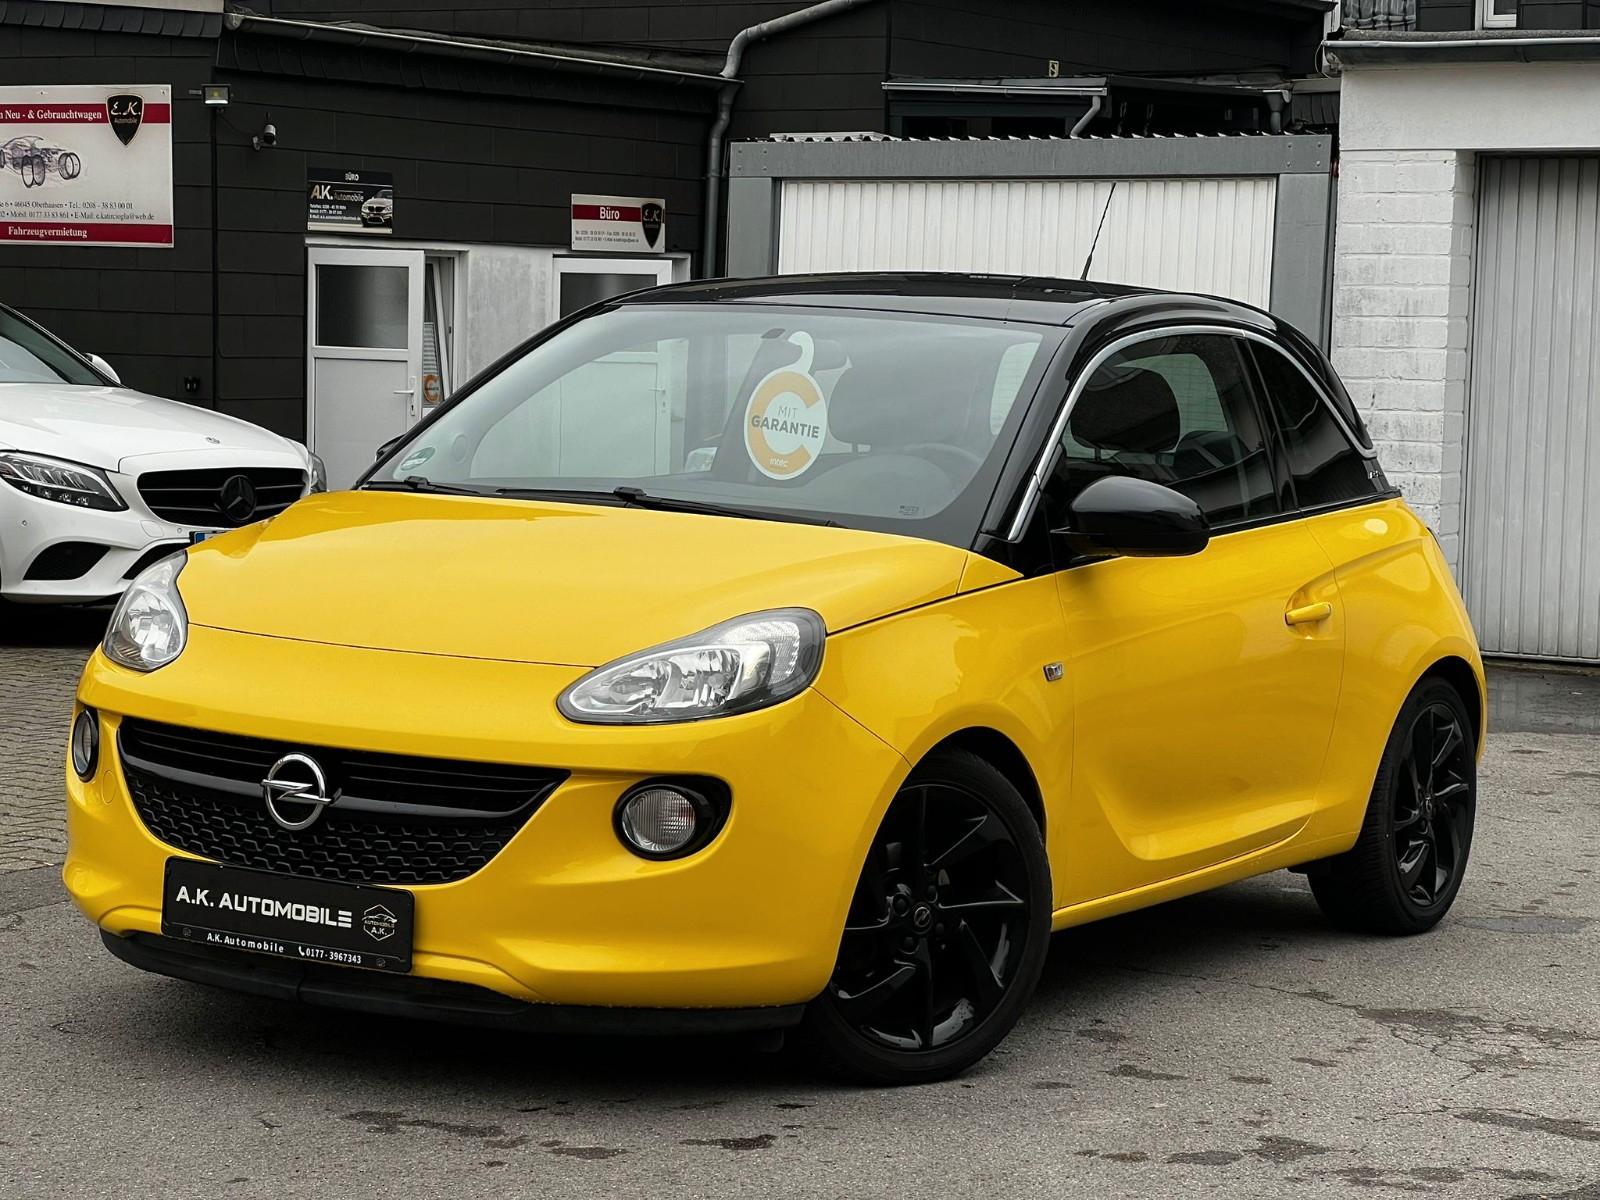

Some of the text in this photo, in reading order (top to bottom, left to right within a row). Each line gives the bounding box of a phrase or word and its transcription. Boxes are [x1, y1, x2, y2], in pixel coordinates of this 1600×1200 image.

[5, 110, 21, 119] Neu
[27, 110, 35, 119] &
[36, 109, 102, 121] Gebrauchtwagen
[310, 184, 334, 200] A.K.
[32, 201, 64, 209] Oberhausen
[599, 206, 620, 220] Büro
[8, 225, 88, 239] Fahrzeugvermietung
[778, 405, 798, 418] MIT
[751, 415, 820, 439] GARANTIE
[176, 886, 353, 929] A.K. AUTOMOBILE
[371, 926, 388, 936] A.K.
[207, 932, 223, 944] A.K.
[224, 935, 285, 954] Automobile
